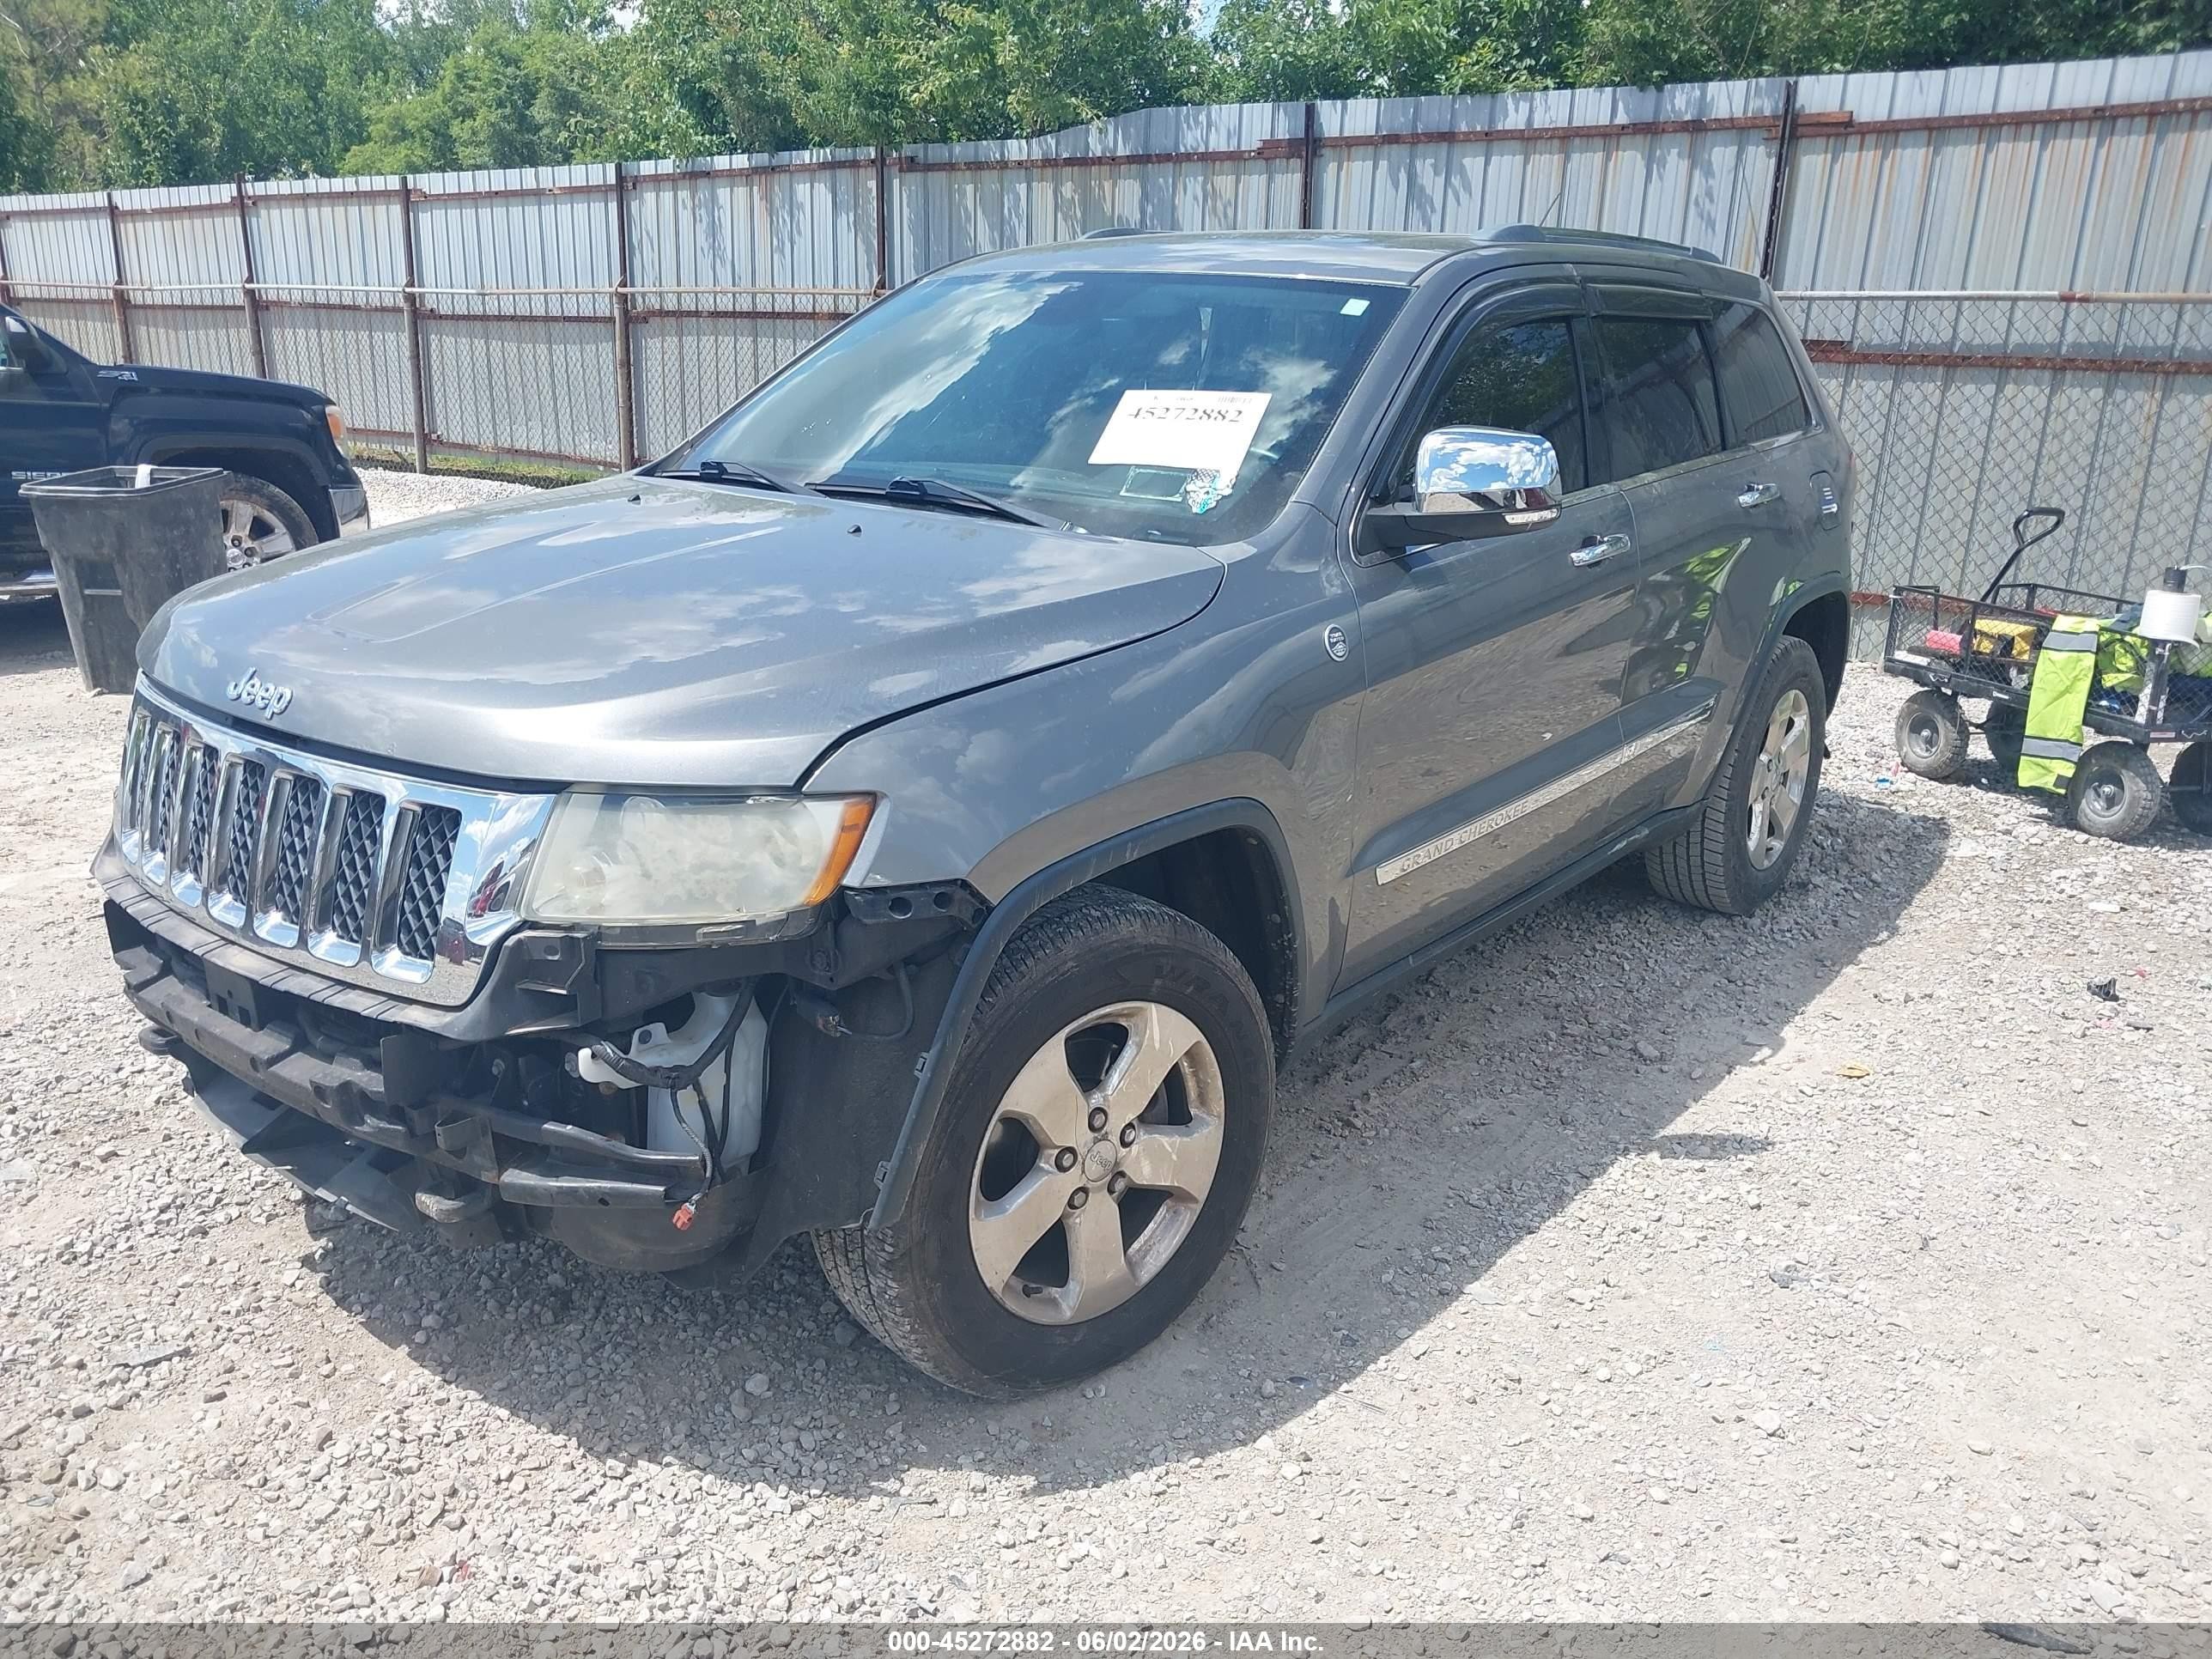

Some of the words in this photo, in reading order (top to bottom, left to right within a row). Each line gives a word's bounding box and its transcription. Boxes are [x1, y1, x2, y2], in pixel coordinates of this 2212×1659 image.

[1127, 406, 1243, 423] 45272882
[227, 666, 294, 720] Jeep
[1401, 837, 1455, 872] GRAND
[1459, 799, 1529, 845] CHEROKEE
[1090, 1151, 1113, 1171] Jeep
